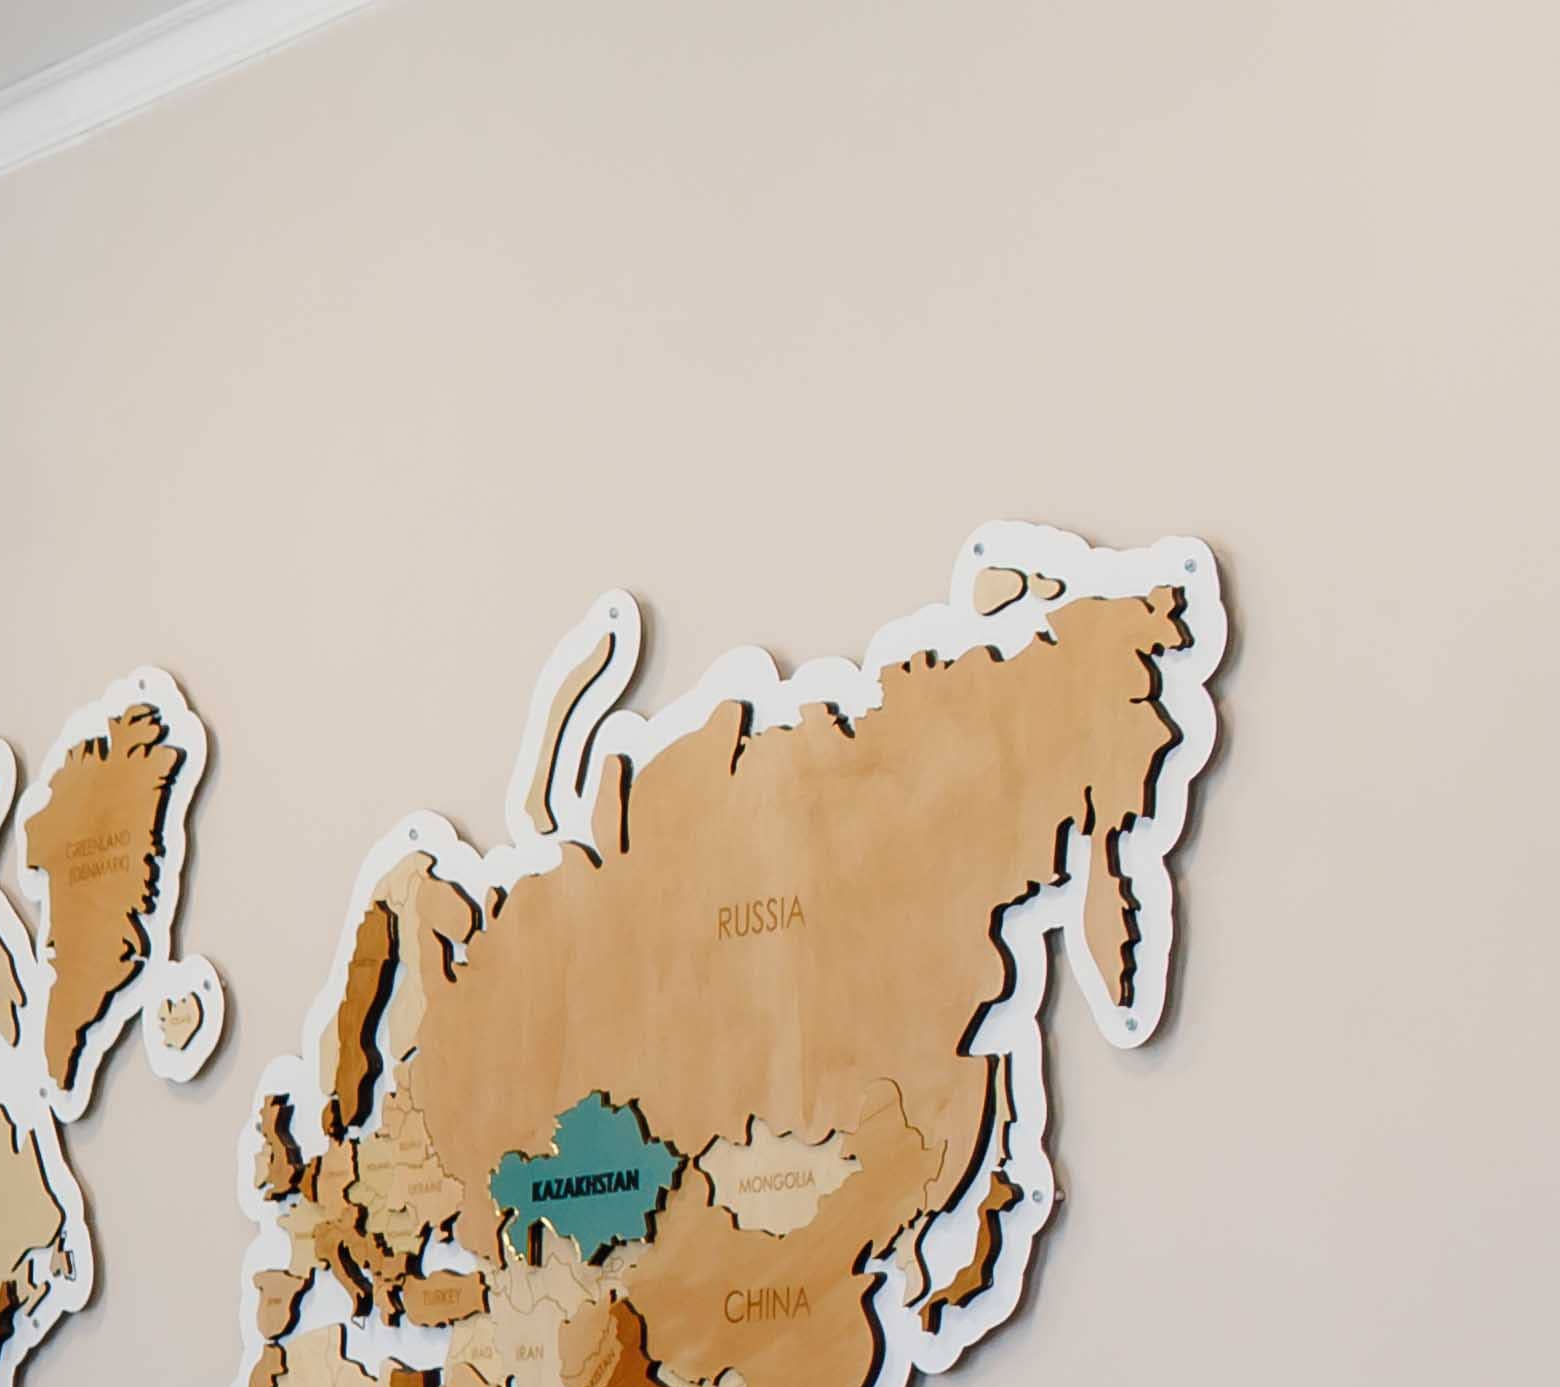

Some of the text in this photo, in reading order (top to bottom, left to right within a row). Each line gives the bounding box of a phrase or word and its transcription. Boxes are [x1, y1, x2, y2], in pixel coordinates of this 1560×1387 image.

[717, 895, 807, 941] RUSSIA
[531, 1168, 640, 1202] KAZAKHSTAN
[738, 1170, 816, 1195] MONGOLIA
[723, 1287, 811, 1323] CHINA
[515, 1345, 545, 1361] IRAN
